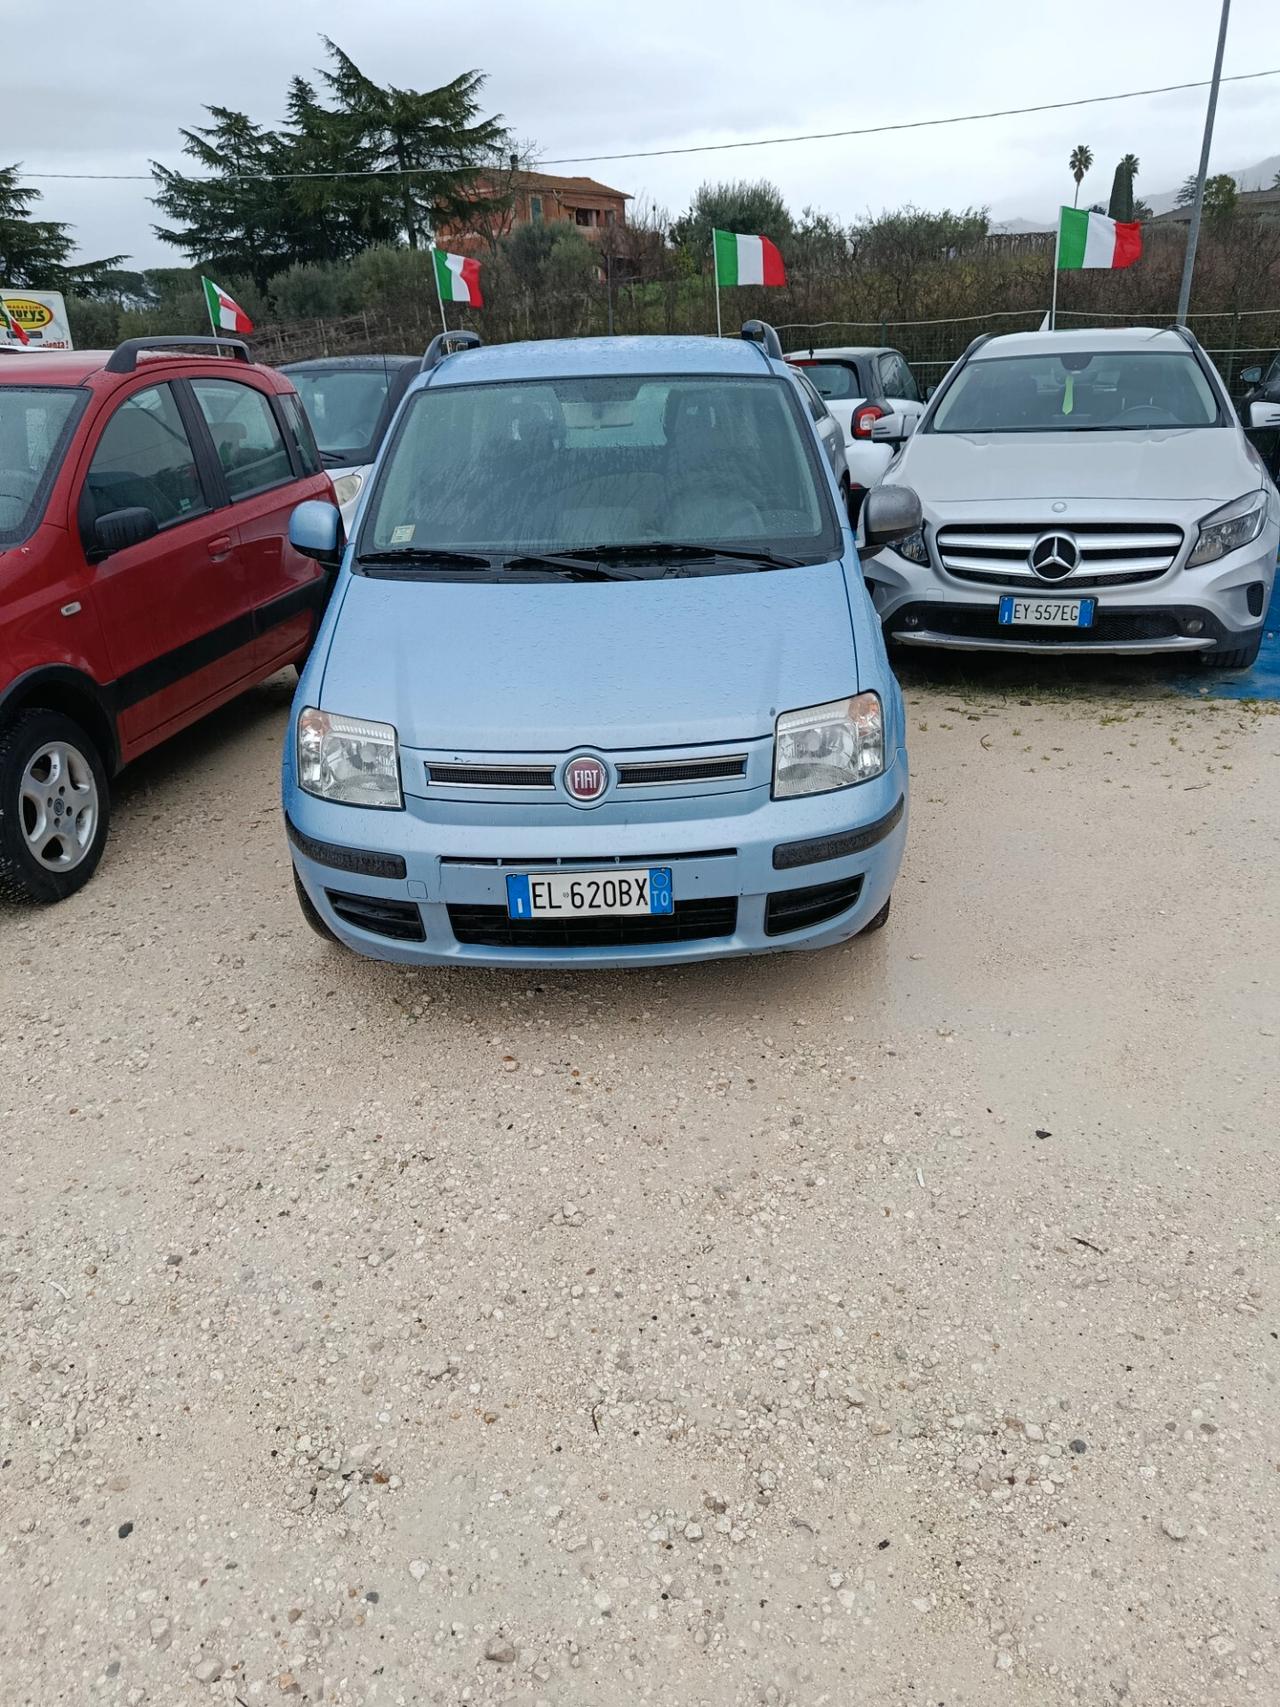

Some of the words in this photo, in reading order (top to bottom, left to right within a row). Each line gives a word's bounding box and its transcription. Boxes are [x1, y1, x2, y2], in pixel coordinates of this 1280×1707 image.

[1014, 604, 1030, 619] EY
[1034, 605, 1079, 621] 557EG
[574, 769, 598, 789] FIAT
[531, 882, 562, 909] EL
[570, 878, 648, 909] 620BX
[652, 890, 669, 907] TO
